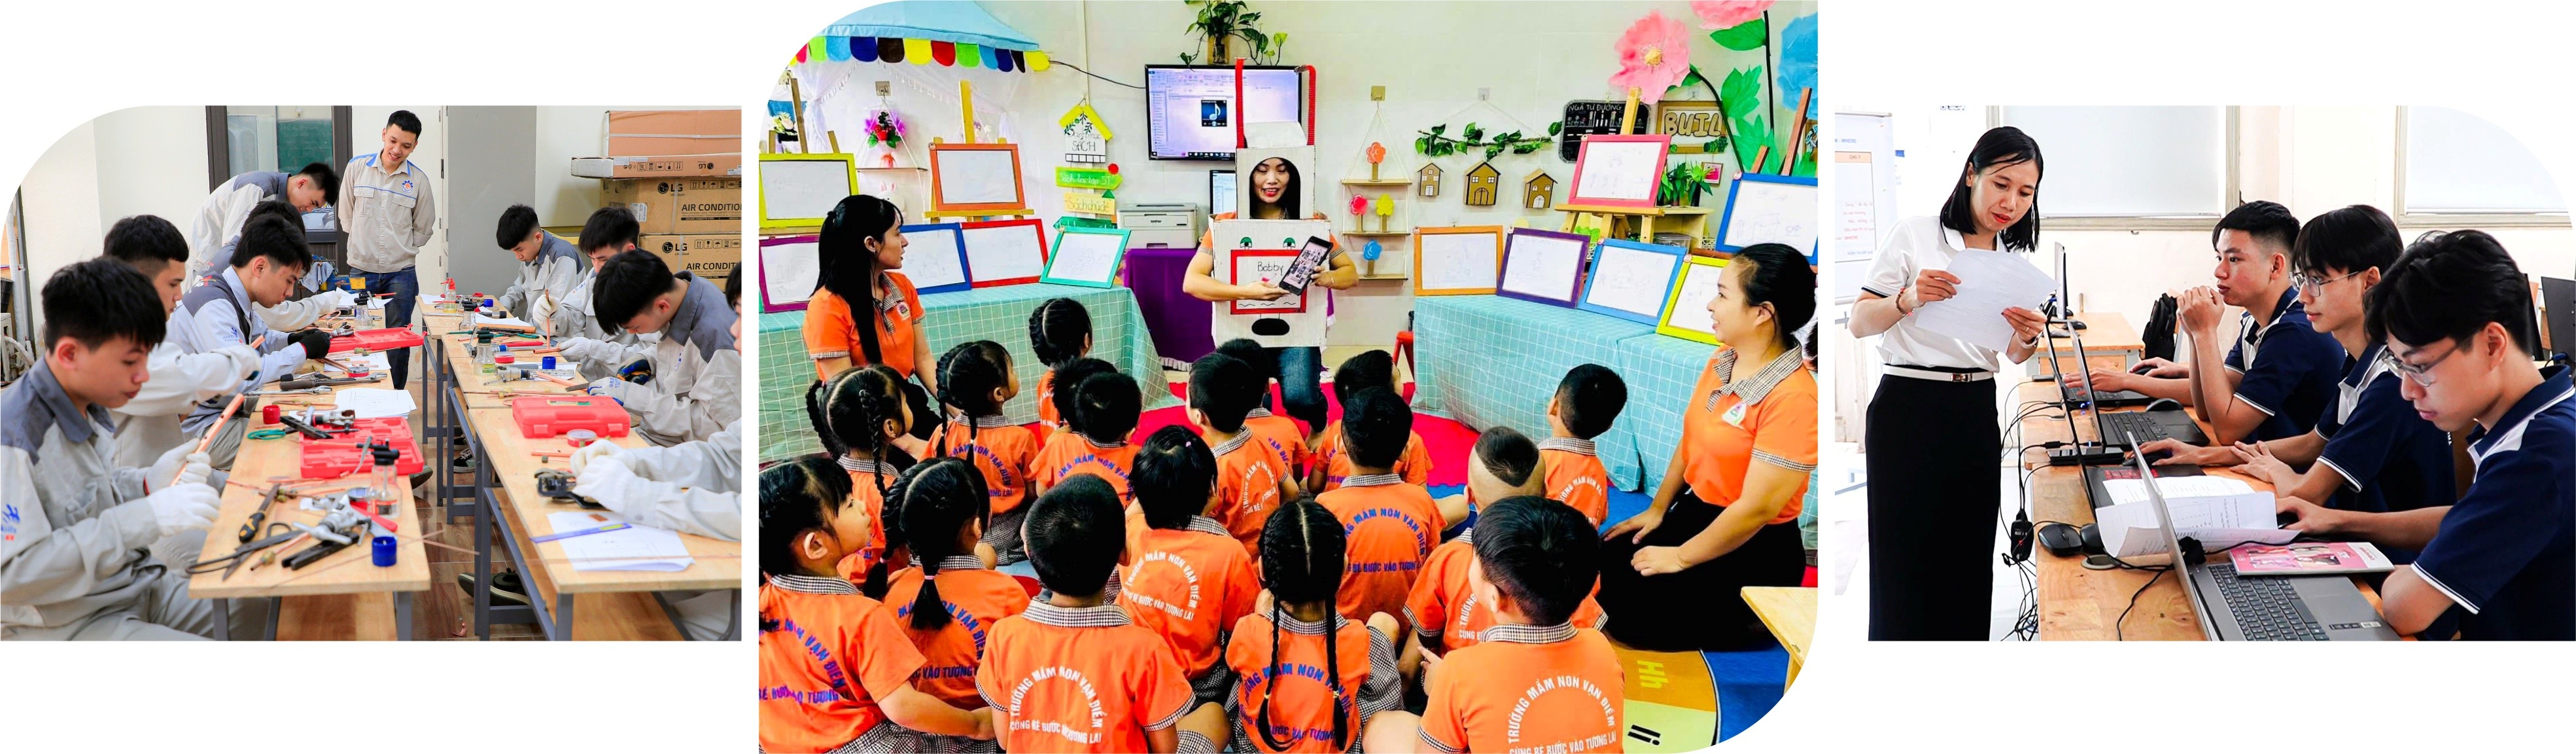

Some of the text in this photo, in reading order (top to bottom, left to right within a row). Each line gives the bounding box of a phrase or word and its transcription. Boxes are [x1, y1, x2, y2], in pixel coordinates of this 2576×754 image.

[698, 203, 742, 211] CONDITIO
[674, 243, 688, 251] LG
[1257, 261, 1283, 276] Bobby
[1380, 508, 1401, 519] NON
[805, 636, 829, 661] VẠN
[1059, 666, 1081, 682] NON
[1079, 676, 1097, 700] VẠN
[1297, 663, 1325, 682] NON
[1637, 660, 1671, 689] Hh
[1508, 675, 1616, 744] TRƯỜNG MẦM NON VẠN ĐIỂM
[1032, 719, 1041, 731] BÉ
[1089, 732, 1102, 744] LAI
[1569, 738, 1584, 753] VÀO
[1586, 734, 1608, 749] TƯƠNG
[1608, 730, 1617, 744] LAI
